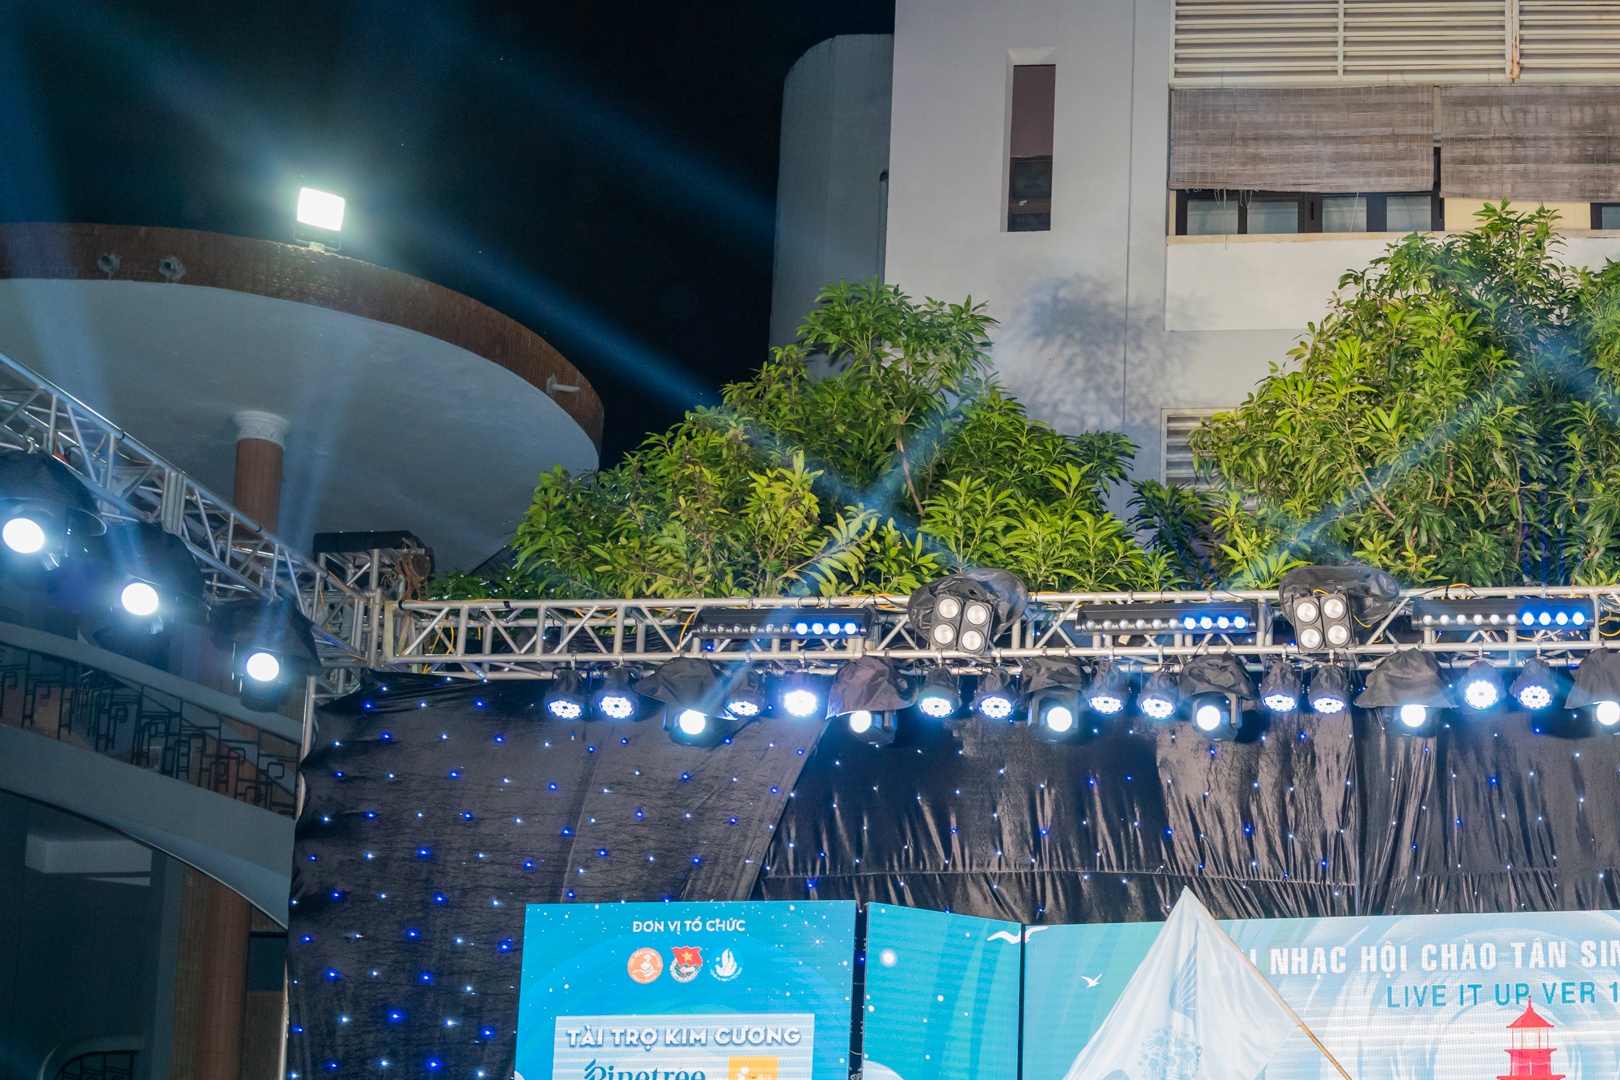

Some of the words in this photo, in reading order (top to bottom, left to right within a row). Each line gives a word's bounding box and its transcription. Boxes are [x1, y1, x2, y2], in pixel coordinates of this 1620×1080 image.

[633, 920, 664, 932] ĐƠN
[668, 921, 681, 935] VỊ
[684, 916, 702, 932] TỔ
[706, 918, 746, 932] CHỨC
[1270, 946, 1347, 979] NHẠC
[1360, 941, 1407, 978] HỘI
[1421, 940, 1496, 971] CHÀO
[1511, 938, 1566, 968] TÂN
[1387, 985, 1447, 1008] LIVE
[1459, 984, 1482, 1006] IT
[1494, 983, 1530, 1006] UP
[1541, 982, 1596, 1005] VER
[566, 1025, 604, 1047] TÀI
[610, 1028, 658, 1052] TRỢ
[664, 1027, 707, 1046] KIM
[714, 1025, 801, 1046] CƯƠNG
